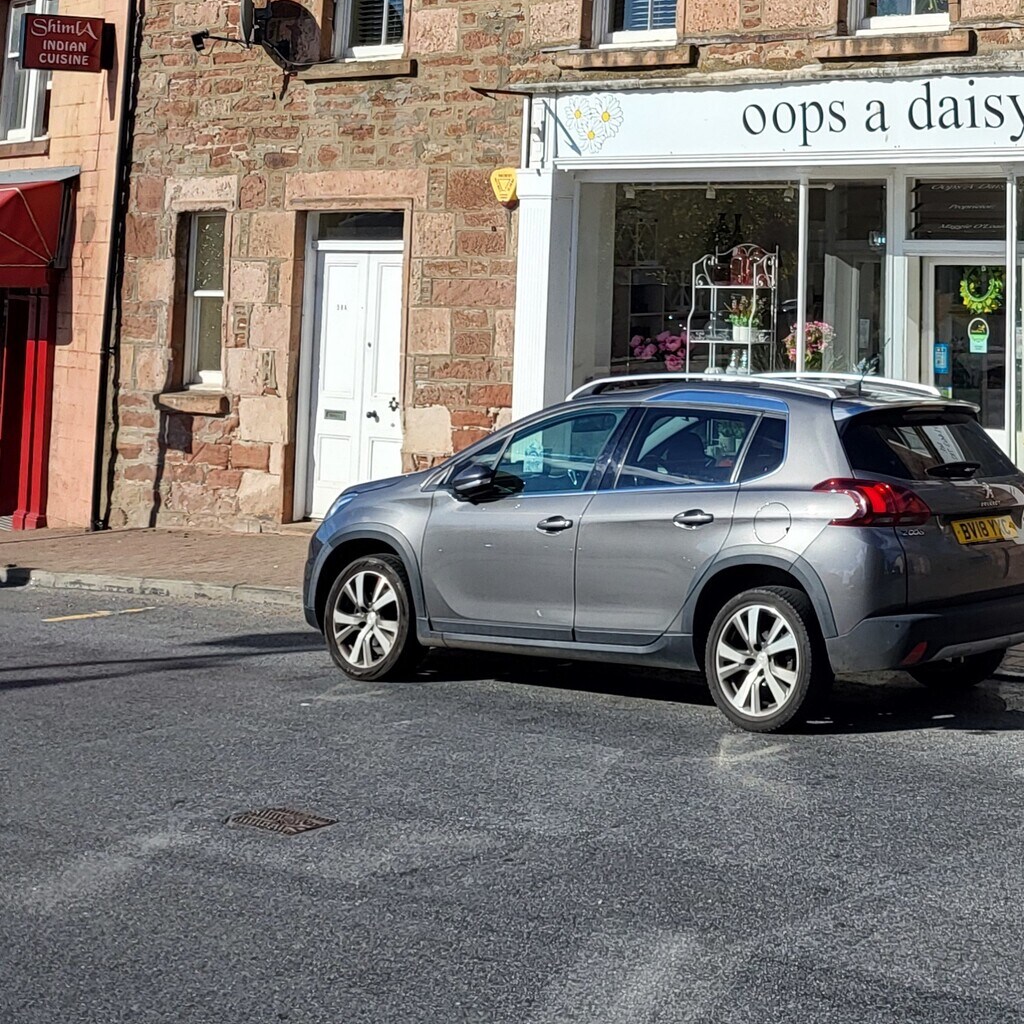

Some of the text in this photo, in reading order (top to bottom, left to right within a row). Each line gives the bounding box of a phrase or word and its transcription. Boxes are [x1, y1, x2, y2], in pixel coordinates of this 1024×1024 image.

[43, 40, 87, 52] INDIAN
[39, 53, 89, 65] CUISINE
[742, 99, 847, 147] oops
[865, 99, 890, 132] a
[959, 521, 989, 540] BV18
